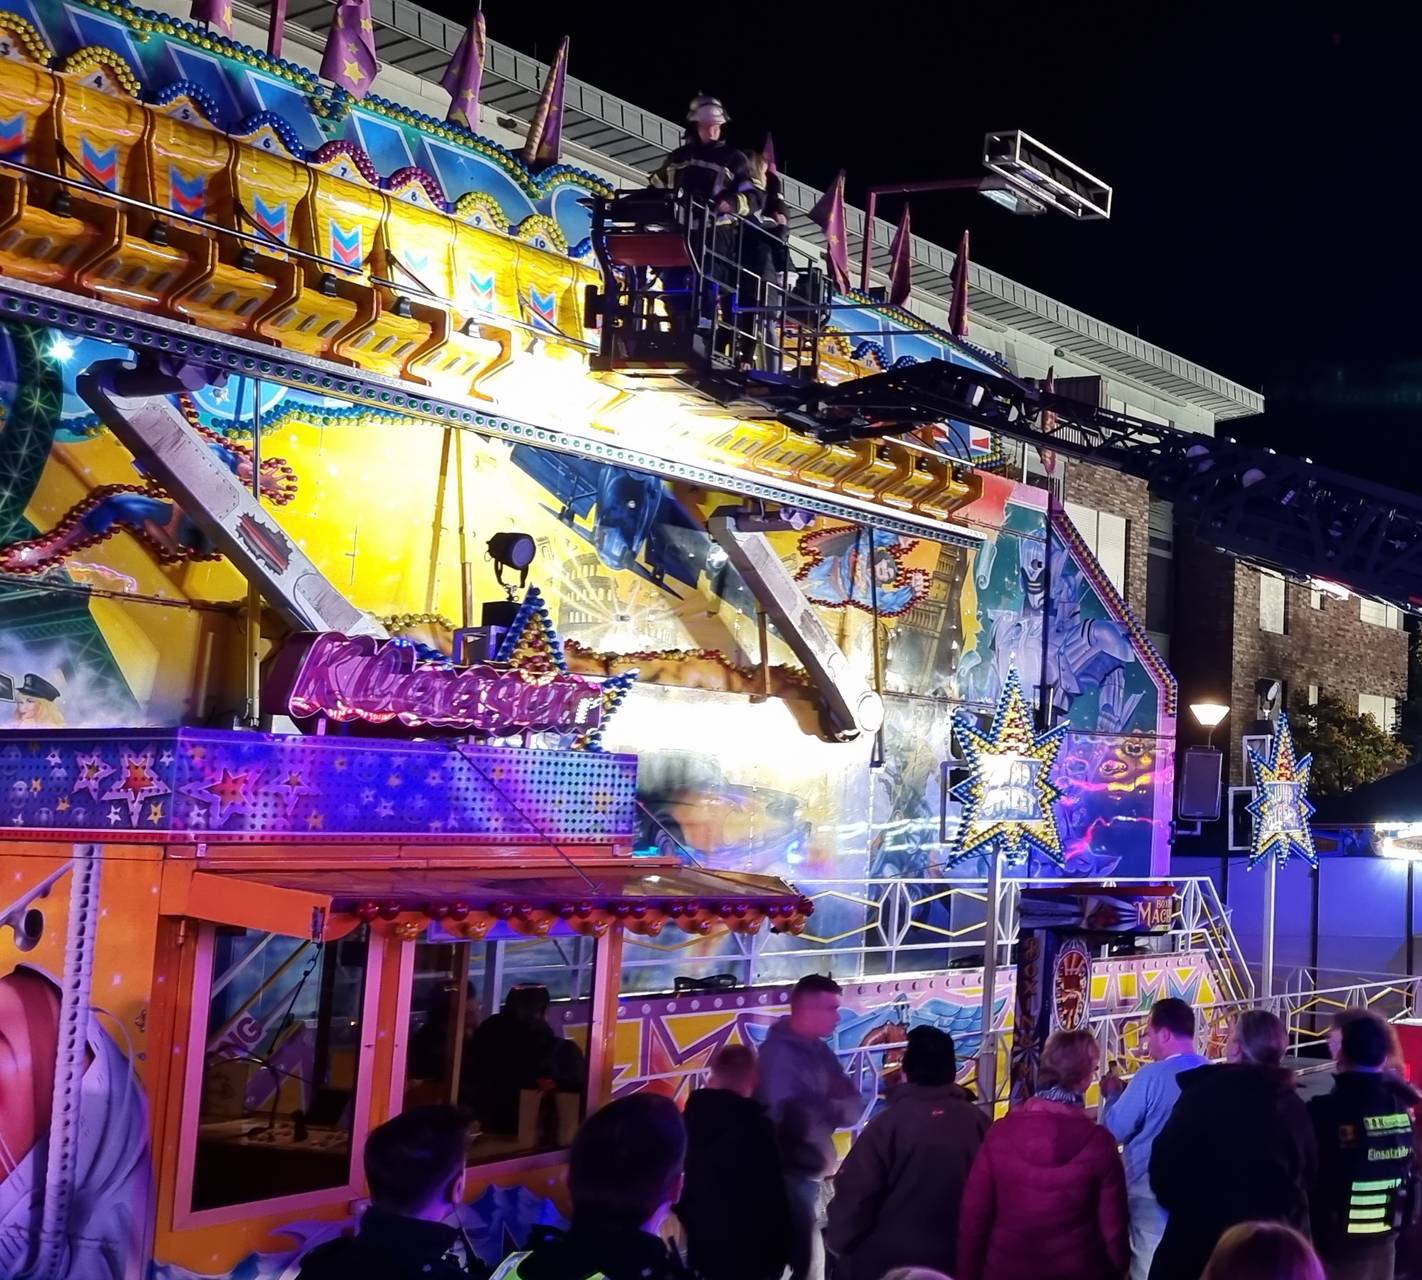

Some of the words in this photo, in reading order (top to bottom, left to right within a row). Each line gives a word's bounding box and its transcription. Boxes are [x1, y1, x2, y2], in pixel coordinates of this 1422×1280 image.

[92, 75, 103, 88] 4
[181, 109, 191, 120] 5
[262, 137, 272, 148] 6
[340, 167, 348, 177] 7
[410, 191, 418, 201] 8
[474, 215, 482, 226] 9
[534, 238, 546, 249] 10
